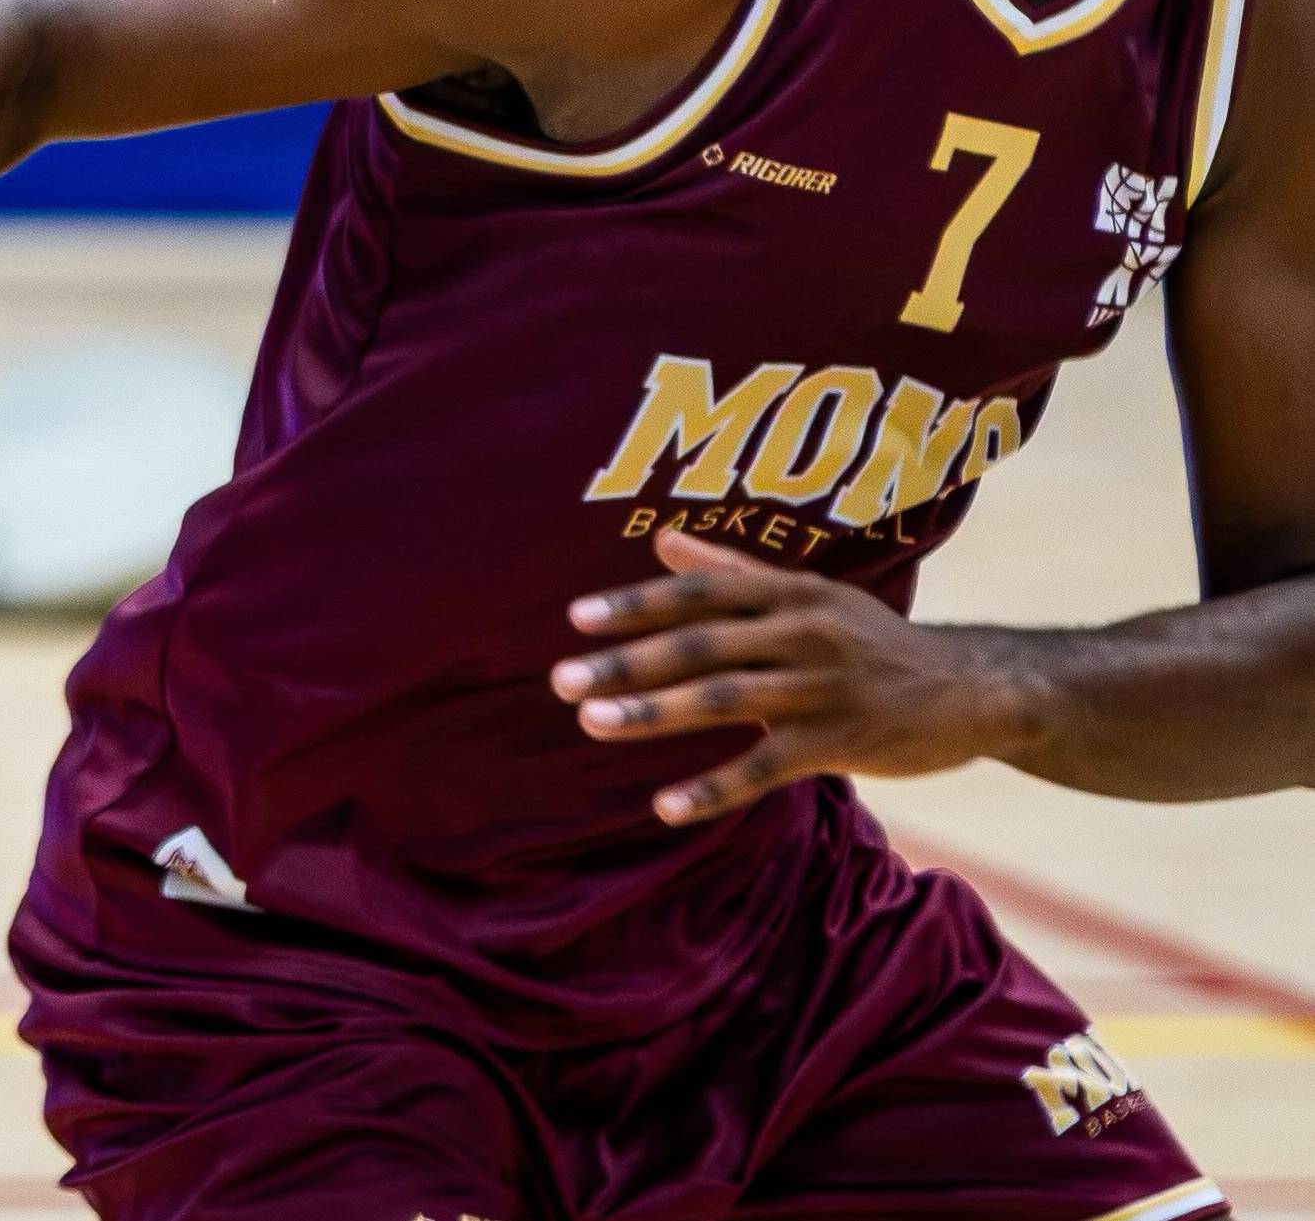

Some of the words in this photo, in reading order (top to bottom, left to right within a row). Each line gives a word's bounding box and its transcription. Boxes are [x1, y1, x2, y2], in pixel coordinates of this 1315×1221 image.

[729, 151, 838, 195] RIGORER
[898, 112, 1040, 333] 7
[1020, 1033, 1142, 1136] MO
